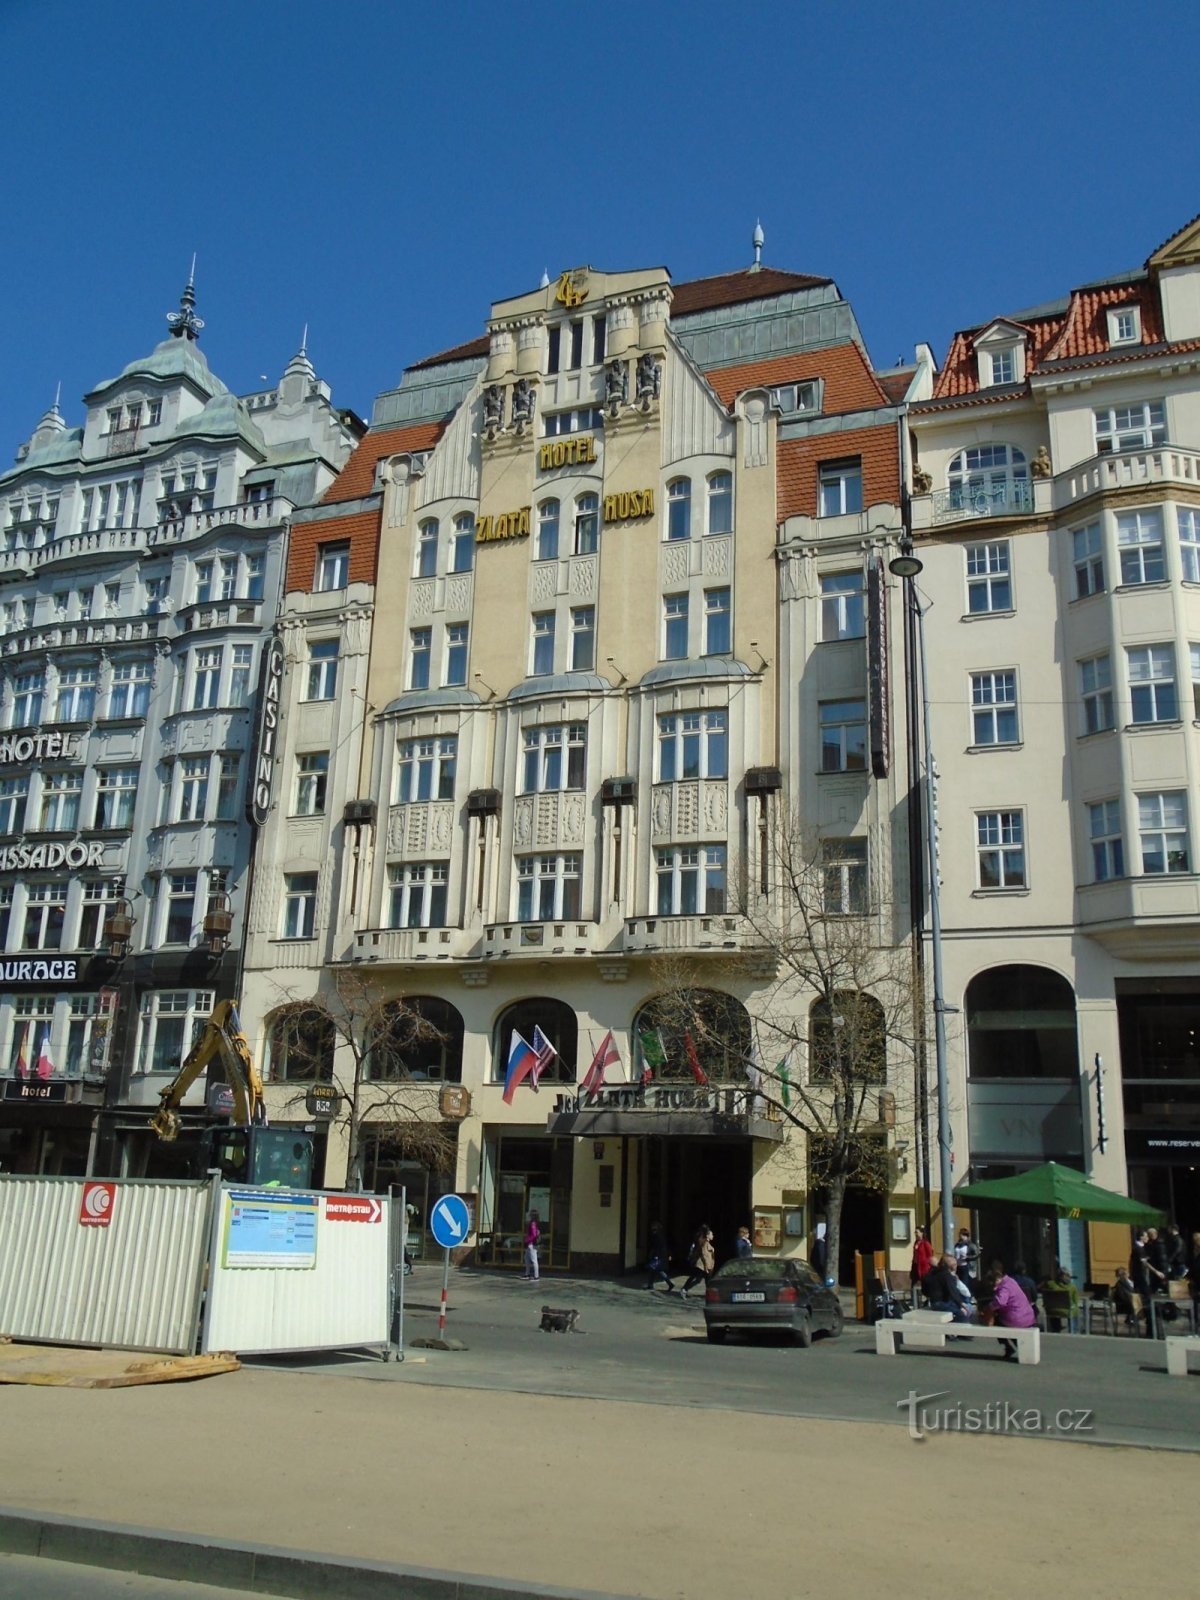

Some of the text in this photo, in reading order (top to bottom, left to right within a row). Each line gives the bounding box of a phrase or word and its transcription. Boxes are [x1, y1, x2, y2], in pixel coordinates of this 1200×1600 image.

[541, 437, 598, 469] HOTEL
[604, 488, 655, 522] HUSA
[257, 651, 283, 809] CASINO
[2, 732, 73, 763] HOTEL
[0, 961, 77, 980] URACE
[21, 1085, 52, 1097] hotel
